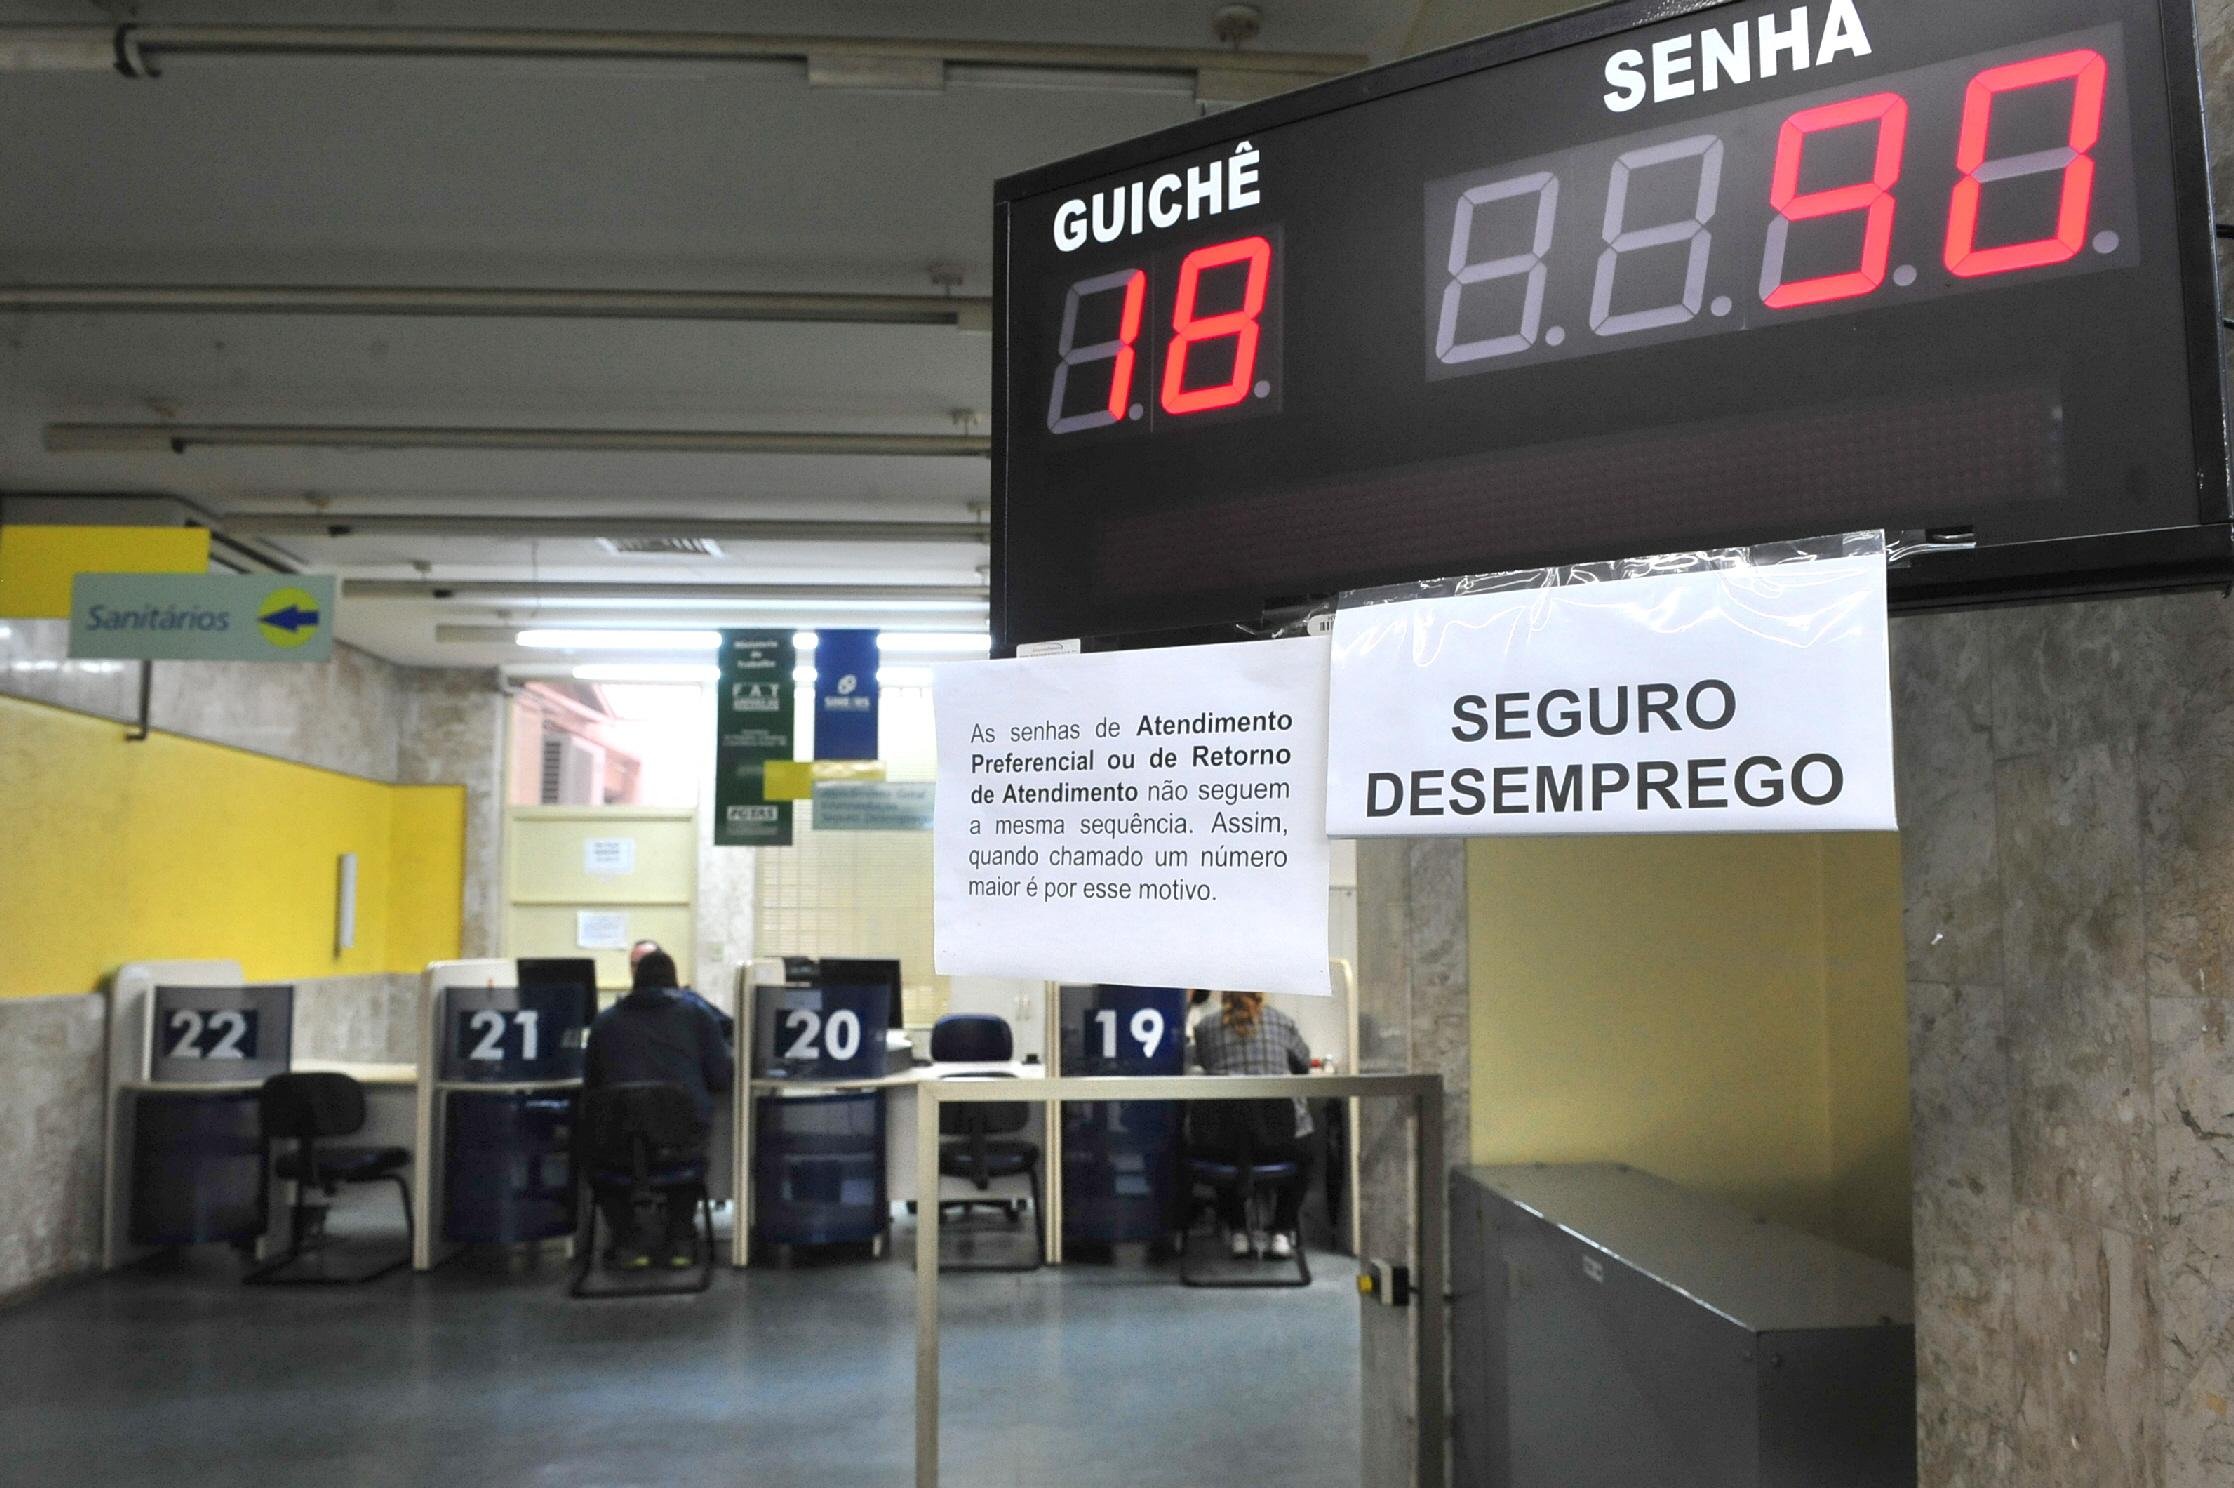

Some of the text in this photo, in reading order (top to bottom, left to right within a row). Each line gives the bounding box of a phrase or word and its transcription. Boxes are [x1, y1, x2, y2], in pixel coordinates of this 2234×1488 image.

[1603, 0, 1871, 112] SENHA
[1053, 140, 1260, 252] GUICHÊ
[1762, 49, 2107, 311] 90
[1108, 236, 1271, 421] 18
[86, 603, 230, 631] Sanitários
[971, 711, 1292, 743] As senhas de Atendimento
[1452, 679, 1736, 742] SEGURO
[972, 746, 1290, 773] Preferencial ou de Retorno
[972, 780, 1289, 805] de Atendimento não seguem
[1367, 753, 1843, 817] DESEMPREGO
[970, 812, 1287, 839] a mesma sequência. Assim,
[969, 845, 1287, 869] quando chamado um número
[969, 876, 1216, 902] maior é por esse motivo.
[168, 1009, 248, 1059] 22
[470, 1010, 538, 1060] 21
[784, 1009, 861, 1060] 20
[1094, 1008, 1164, 1059] 19
